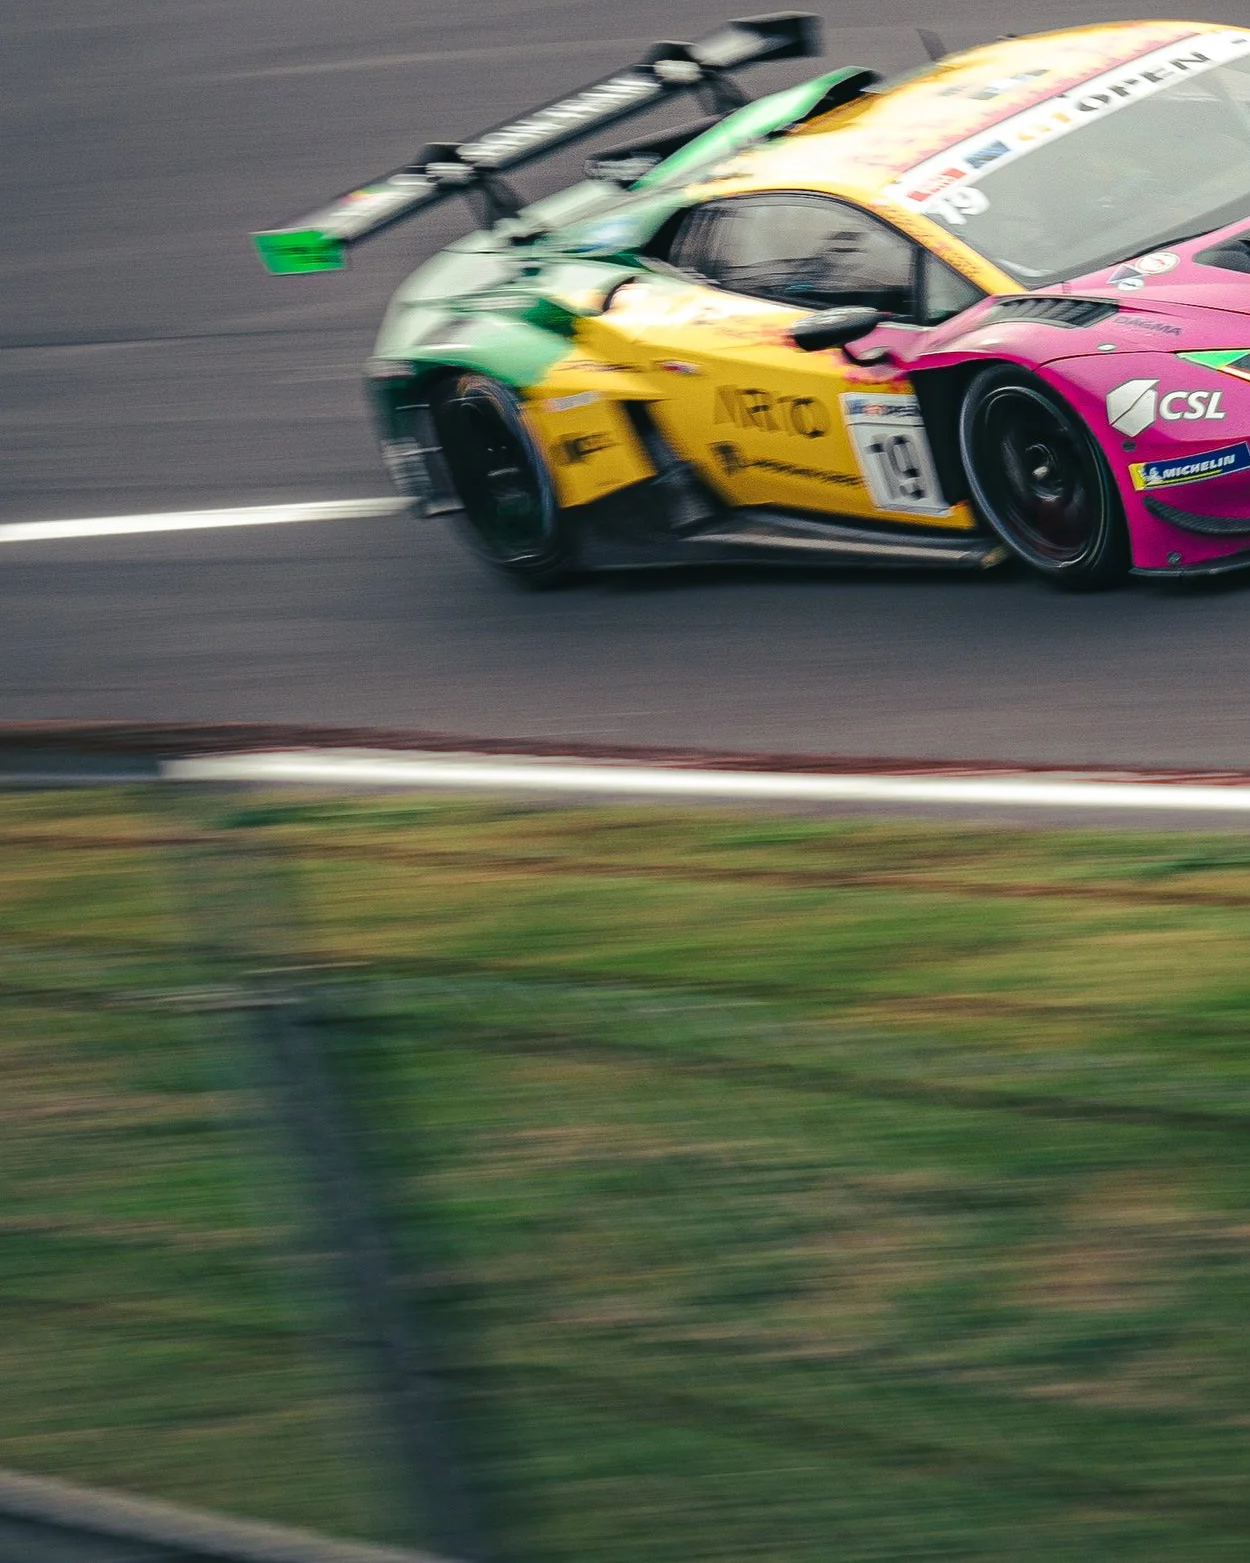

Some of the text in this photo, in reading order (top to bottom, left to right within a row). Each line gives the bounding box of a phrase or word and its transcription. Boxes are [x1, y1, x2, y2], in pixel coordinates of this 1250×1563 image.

[1075, 51, 1211, 112] OPEN
[1159, 391, 1226, 420] CSL
[865, 435, 926, 501] 19
[1162, 453, 1236, 479] MICHELIN
